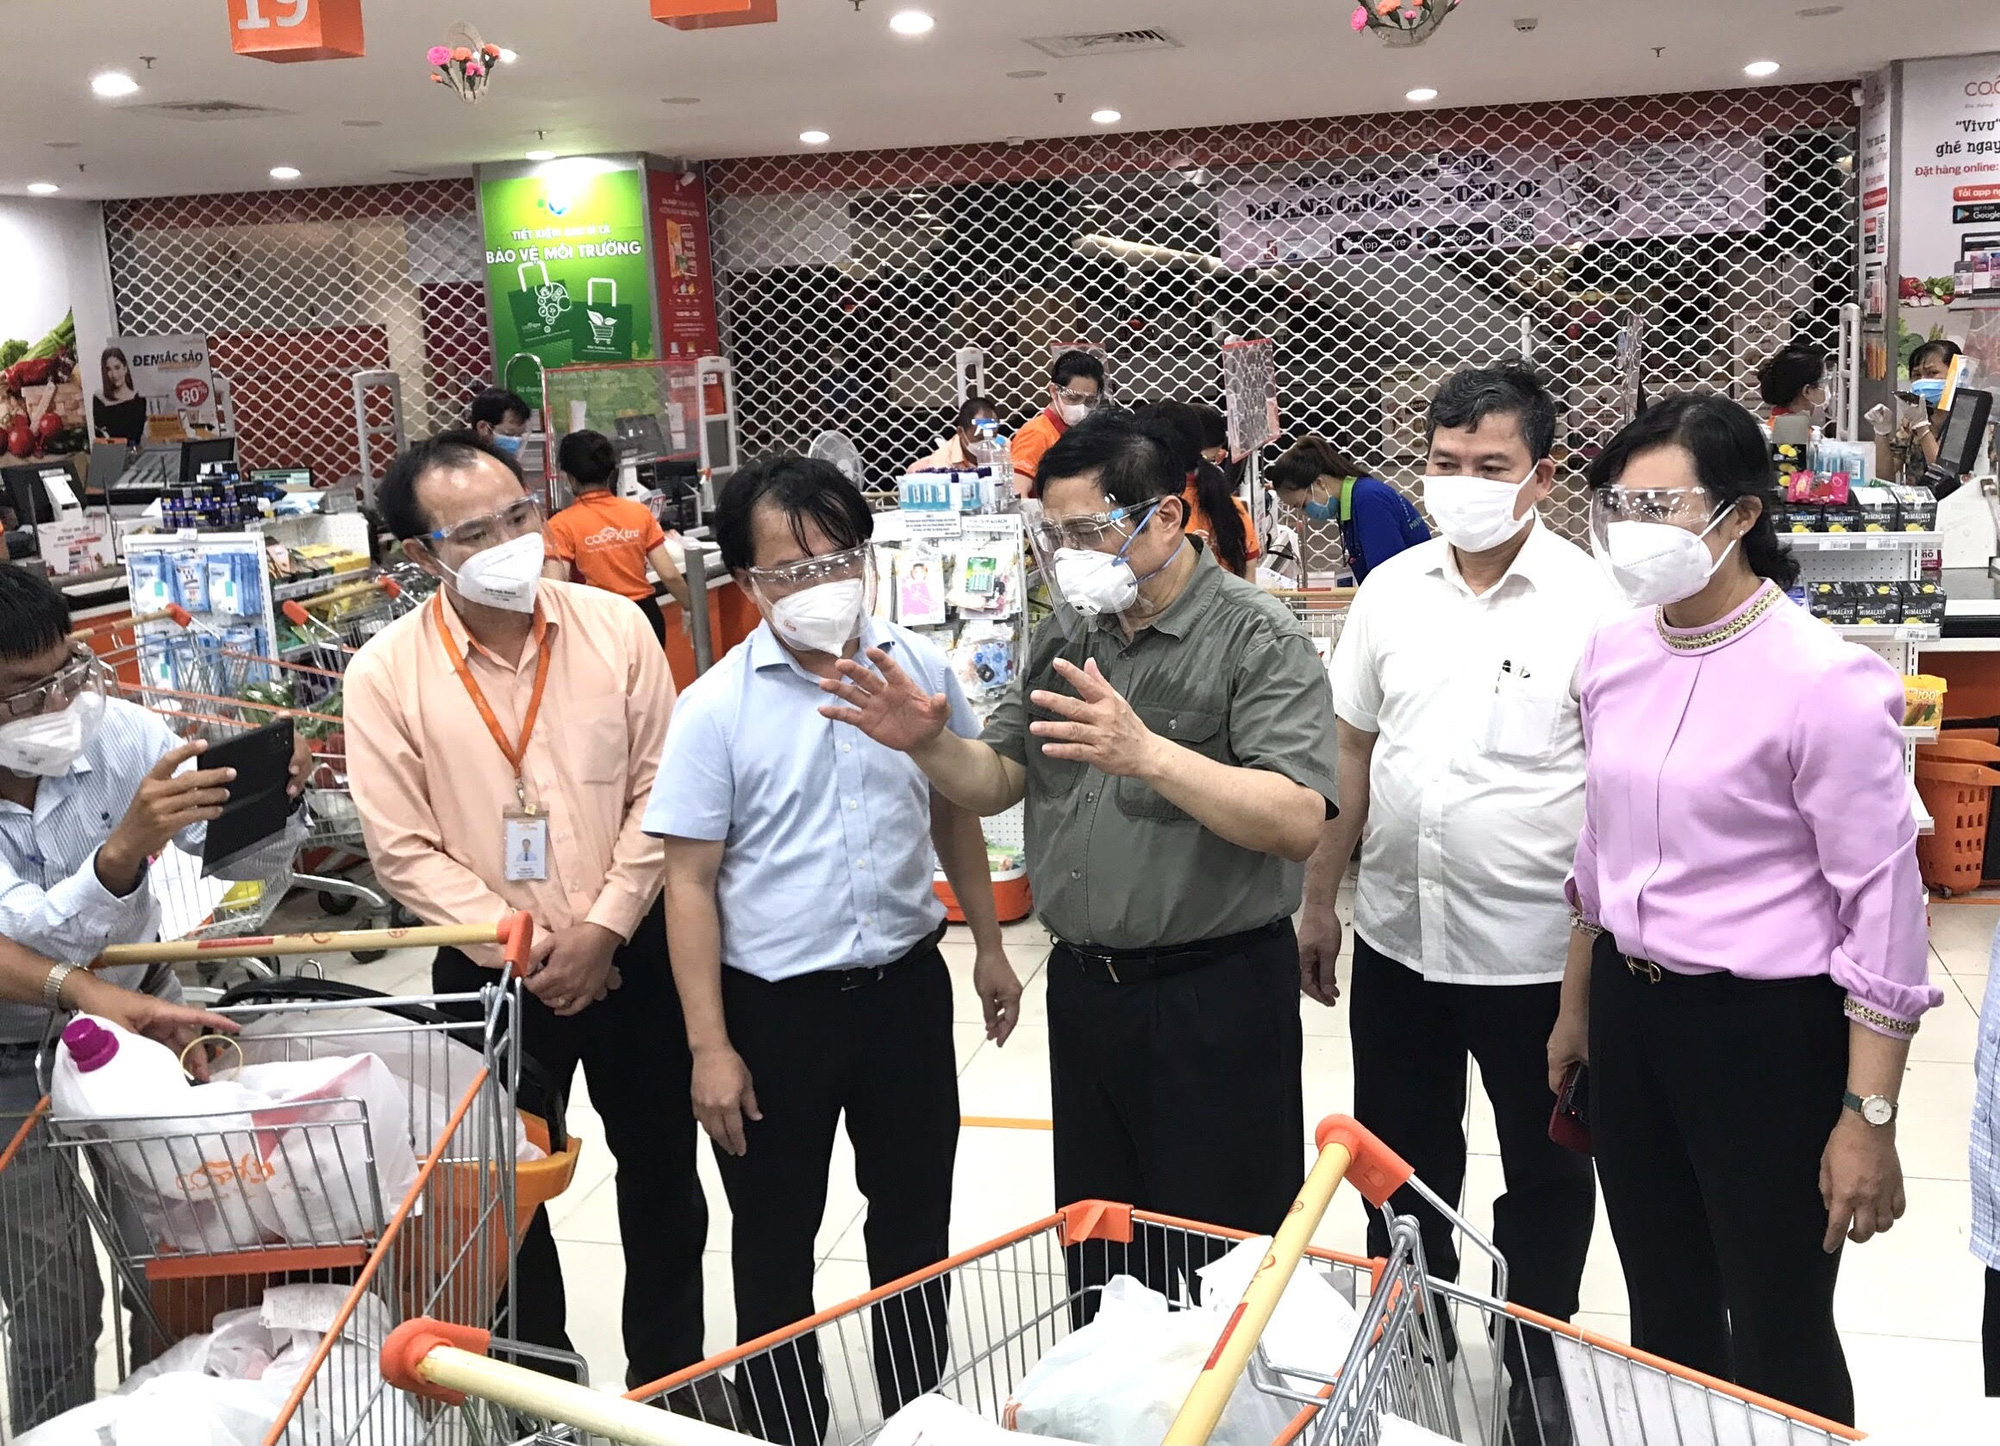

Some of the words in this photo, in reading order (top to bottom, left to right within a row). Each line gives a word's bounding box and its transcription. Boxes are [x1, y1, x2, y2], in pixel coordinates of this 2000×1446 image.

[1935, 140, 1962, 157] ghé
[1915, 166, 1933, 177] Đặt
[1935, 164, 1961, 176] hàng
[1963, 162, 1999, 173] online:
[1972, 189, 1991, 198] app
[577, 239, 642, 258] TRƯỜNG
[132, 354, 159, 367] ĐEN
